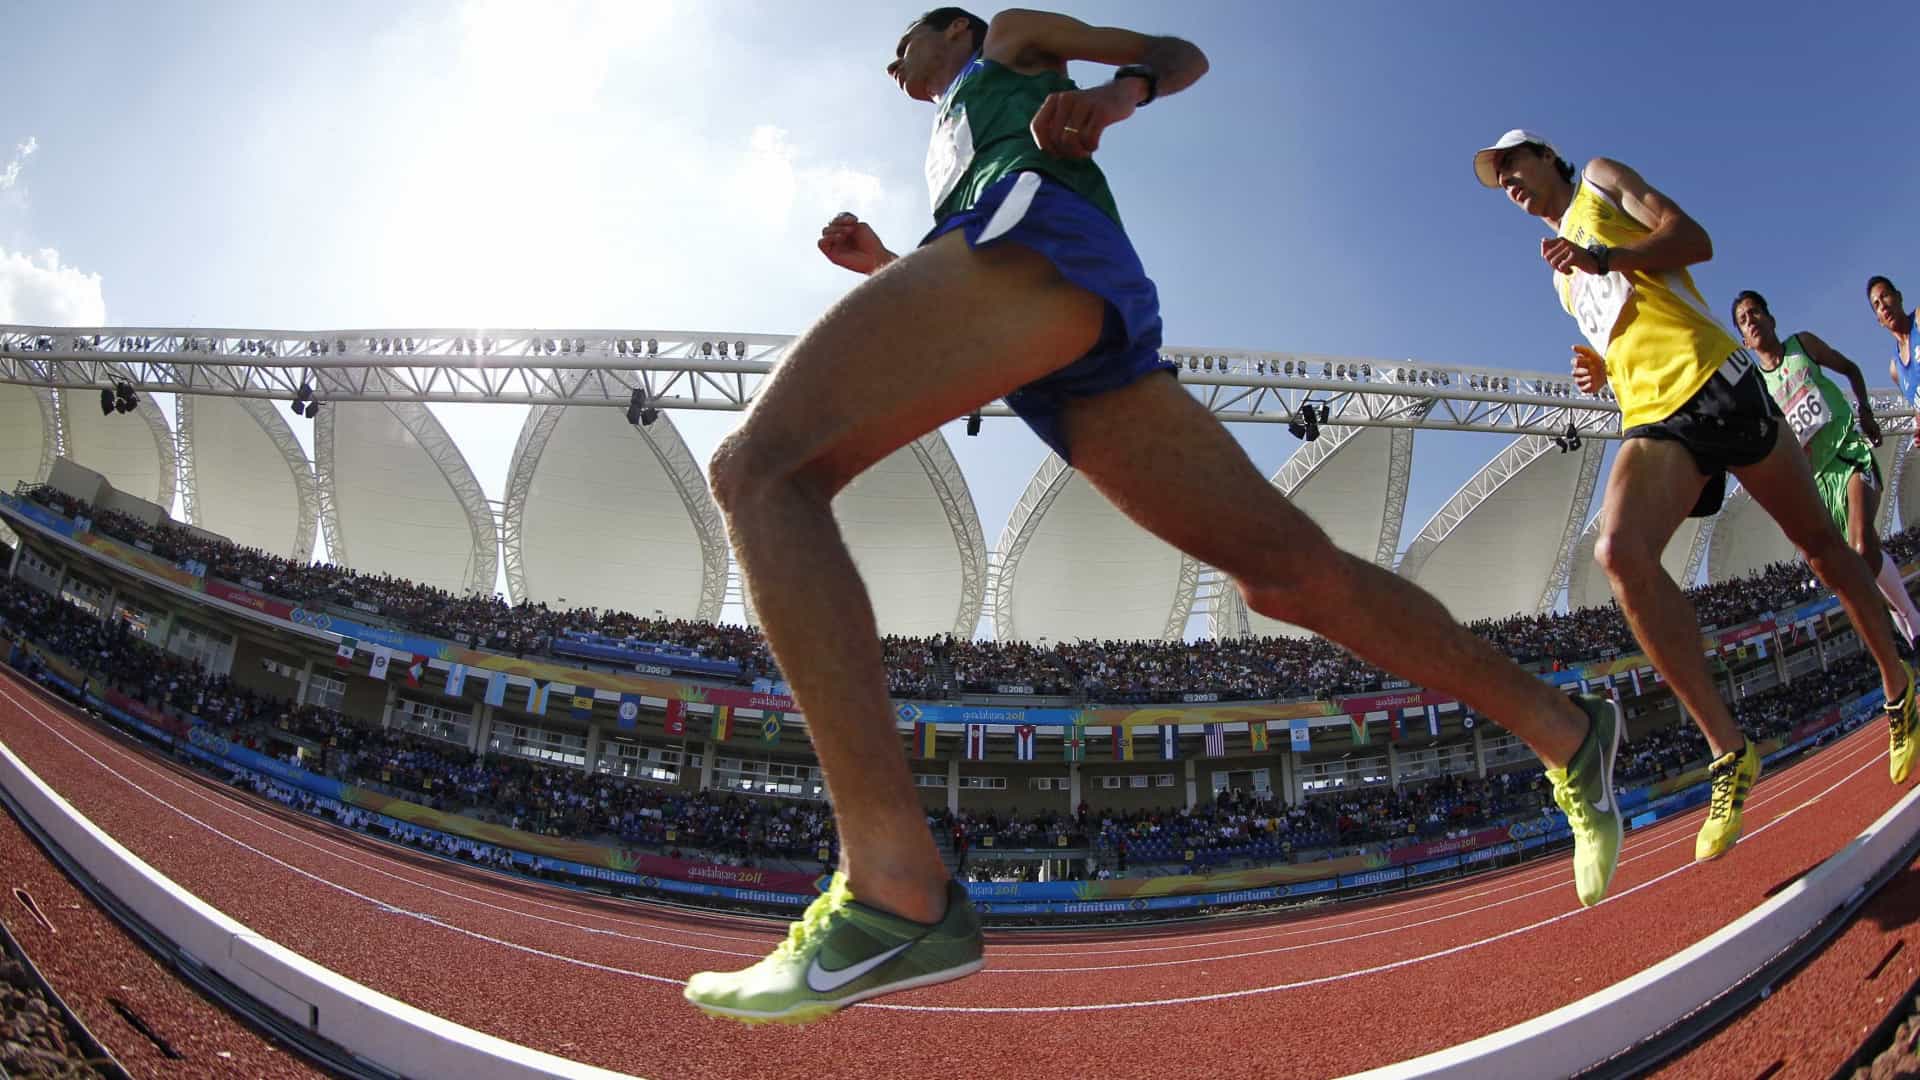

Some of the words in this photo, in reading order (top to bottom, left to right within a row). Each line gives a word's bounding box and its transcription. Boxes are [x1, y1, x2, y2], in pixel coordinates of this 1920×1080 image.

[1788, 394, 1822, 437] 666
[1005, 710, 1025, 722] 2011
[579, 865, 637, 885] infinitum
[737, 871, 763, 885] 2011
[1354, 870, 1400, 886] infinitum
[735, 888, 798, 905] infinitum
[1216, 889, 1271, 904] infinitum
[1064, 900, 1125, 913] infinitum
